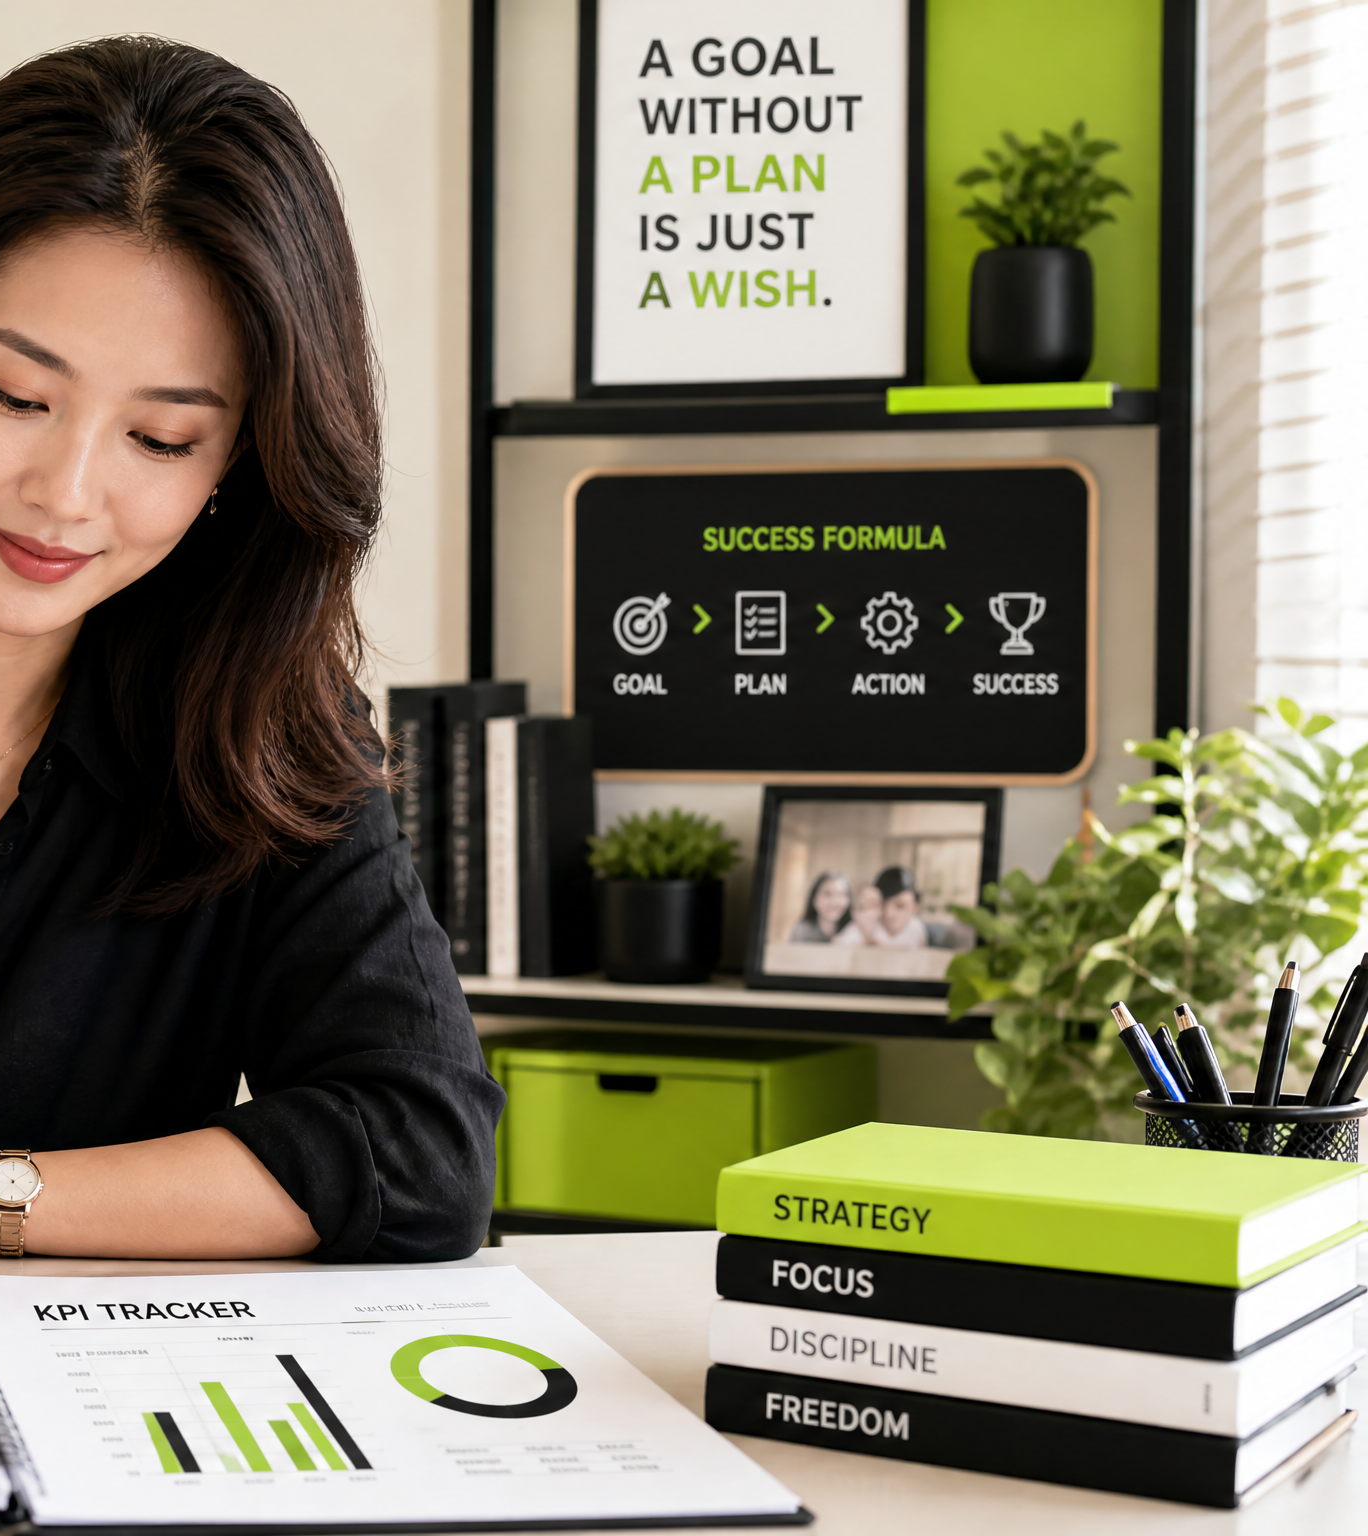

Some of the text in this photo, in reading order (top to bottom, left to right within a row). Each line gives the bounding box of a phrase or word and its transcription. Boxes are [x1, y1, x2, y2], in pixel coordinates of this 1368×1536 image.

[638, 36, 835, 78] A GOAL
[638, 94, 863, 136] WITHOUT
[638, 153, 825, 194] A PLAN
[640, 212, 815, 252] IS JUST
[638, 269, 832, 309] A WISH.
[702, 524, 947, 552] SUCCESS FORMULA
[612, 672, 669, 696] GOAL
[734, 672, 787, 695] PLAN
[851, 672, 926, 696] ACTION
[972, 672, 1060, 696] SUCCESS
[773, 1194, 932, 1235] STRATEGY
[772, 1259, 875, 1299] FOCUS
[33, 1301, 256, 1322] KPI TRACKER
[770, 1325, 938, 1375] DISCIPLINE
[765, 1392, 910, 1441] FREEDOM
